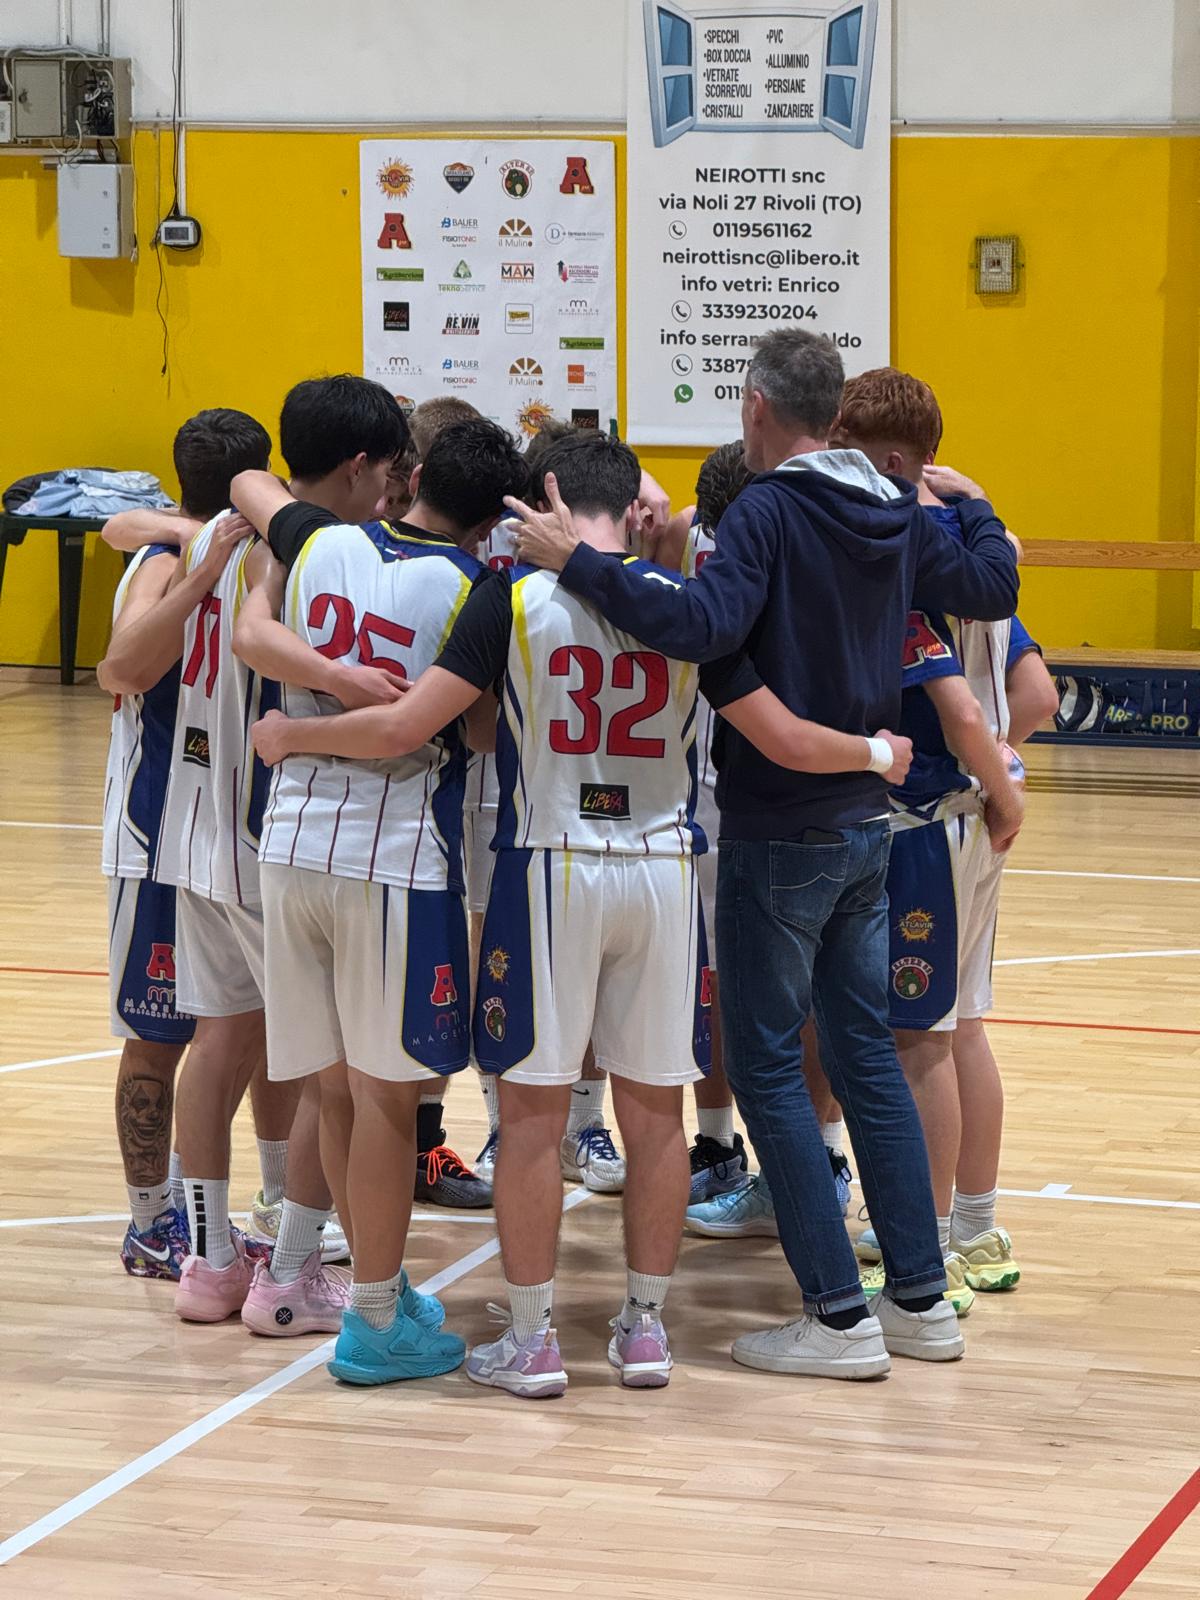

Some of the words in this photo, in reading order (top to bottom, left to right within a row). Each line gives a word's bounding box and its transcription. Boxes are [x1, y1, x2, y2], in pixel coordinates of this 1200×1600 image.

[707, 29, 739, 44] SPECCHI
[769, 29, 783, 44] PVC
[706, 49, 722, 63] BOX
[724, 49, 751, 63] DOCCIA
[768, 54, 809, 69] ALLUMINIO
[706, 68, 739, 82] VETRATE
[705, 84, 752, 98] SCORREVOLI
[767, 79, 806, 93] PERSIANE
[705, 104, 743, 118] CRISTALLI
[767, 104, 814, 118] ZANZARIERE
[696, 168, 785, 183] NEIROTTI
[792, 171, 825, 183] snc
[659, 193, 686, 209] via
[693, 194, 728, 210] Noli
[734, 195, 757, 210] 27
[763, 194, 816, 211] Rivoli
[823, 195, 861, 215] (TO)
[452, 219, 478, 227] BAUER
[713, 222, 812, 238] 0119561162
[505, 239, 533, 248] Mulino
[663, 248, 860, 269] neirottisnc@libero.it
[501, 264, 534, 278] MAW
[682, 275, 717, 291] info
[722, 276, 772, 292] vetri:
[779, 276, 840, 293] Enrico
[702, 304, 818, 320] 3339230204
[445, 317, 480, 329] RE.VIN
[661, 329, 696, 345] info
[453, 360, 479, 368] BAUER
[515, 378, 543, 387] Mulino
[549, 645, 669, 758] 32
[1151, 714, 1190, 730] PRO
